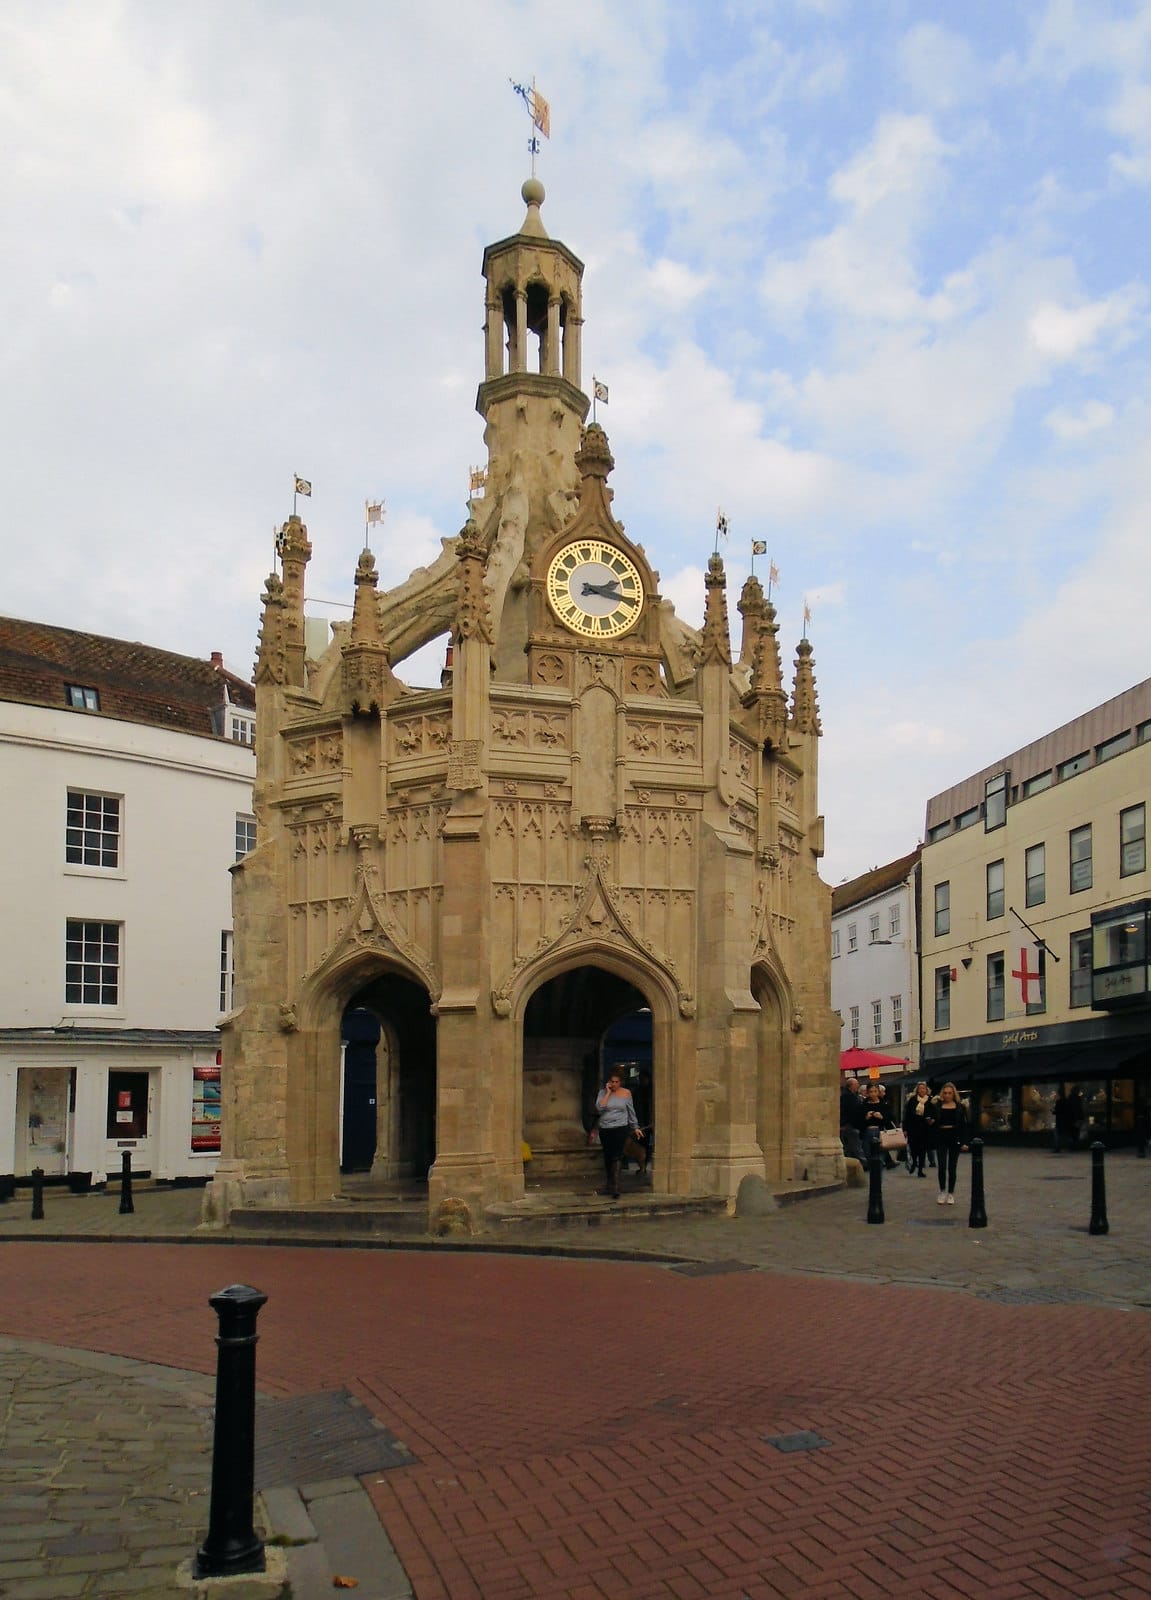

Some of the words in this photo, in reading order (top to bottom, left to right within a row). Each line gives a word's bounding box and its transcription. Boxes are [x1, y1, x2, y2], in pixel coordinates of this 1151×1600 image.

[572, 549, 584, 564] XI
[590, 547, 602, 562] XII
[557, 564, 572, 575] X
[619, 571, 631, 580] II
[554, 580, 568, 590] IX
[623, 589, 637, 598] III
[591, 616, 602, 631] VI
